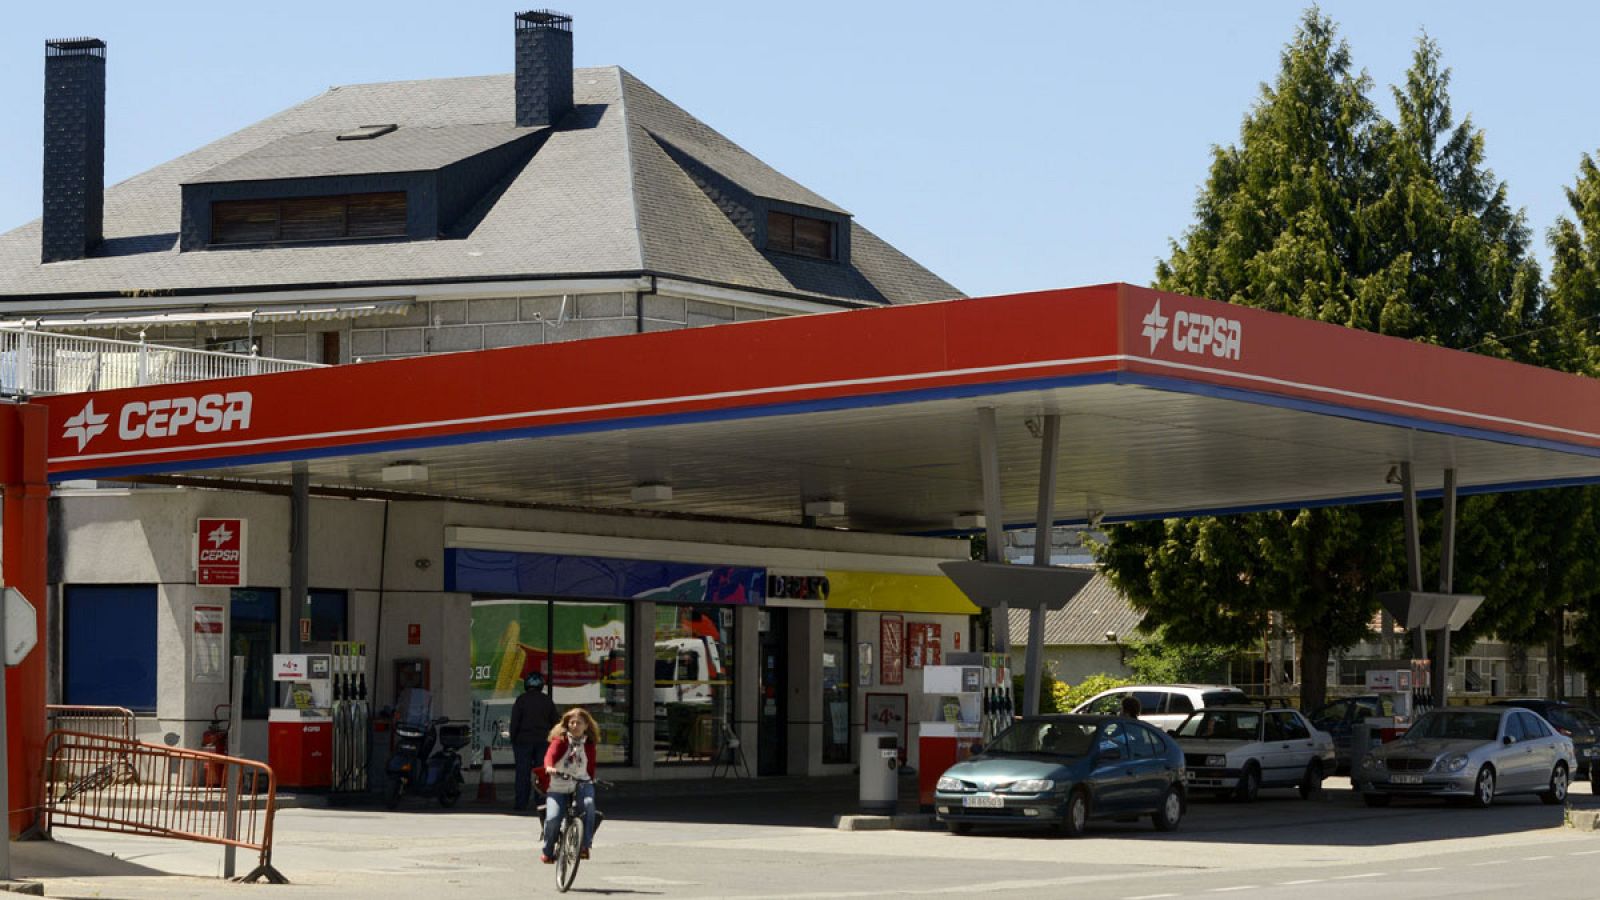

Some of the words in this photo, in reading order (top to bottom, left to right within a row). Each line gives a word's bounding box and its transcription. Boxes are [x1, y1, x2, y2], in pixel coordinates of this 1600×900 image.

[1172, 310, 1242, 361] CEPSA
[118, 391, 253, 441] CEPSA
[200, 549, 240, 561] CEPSA
